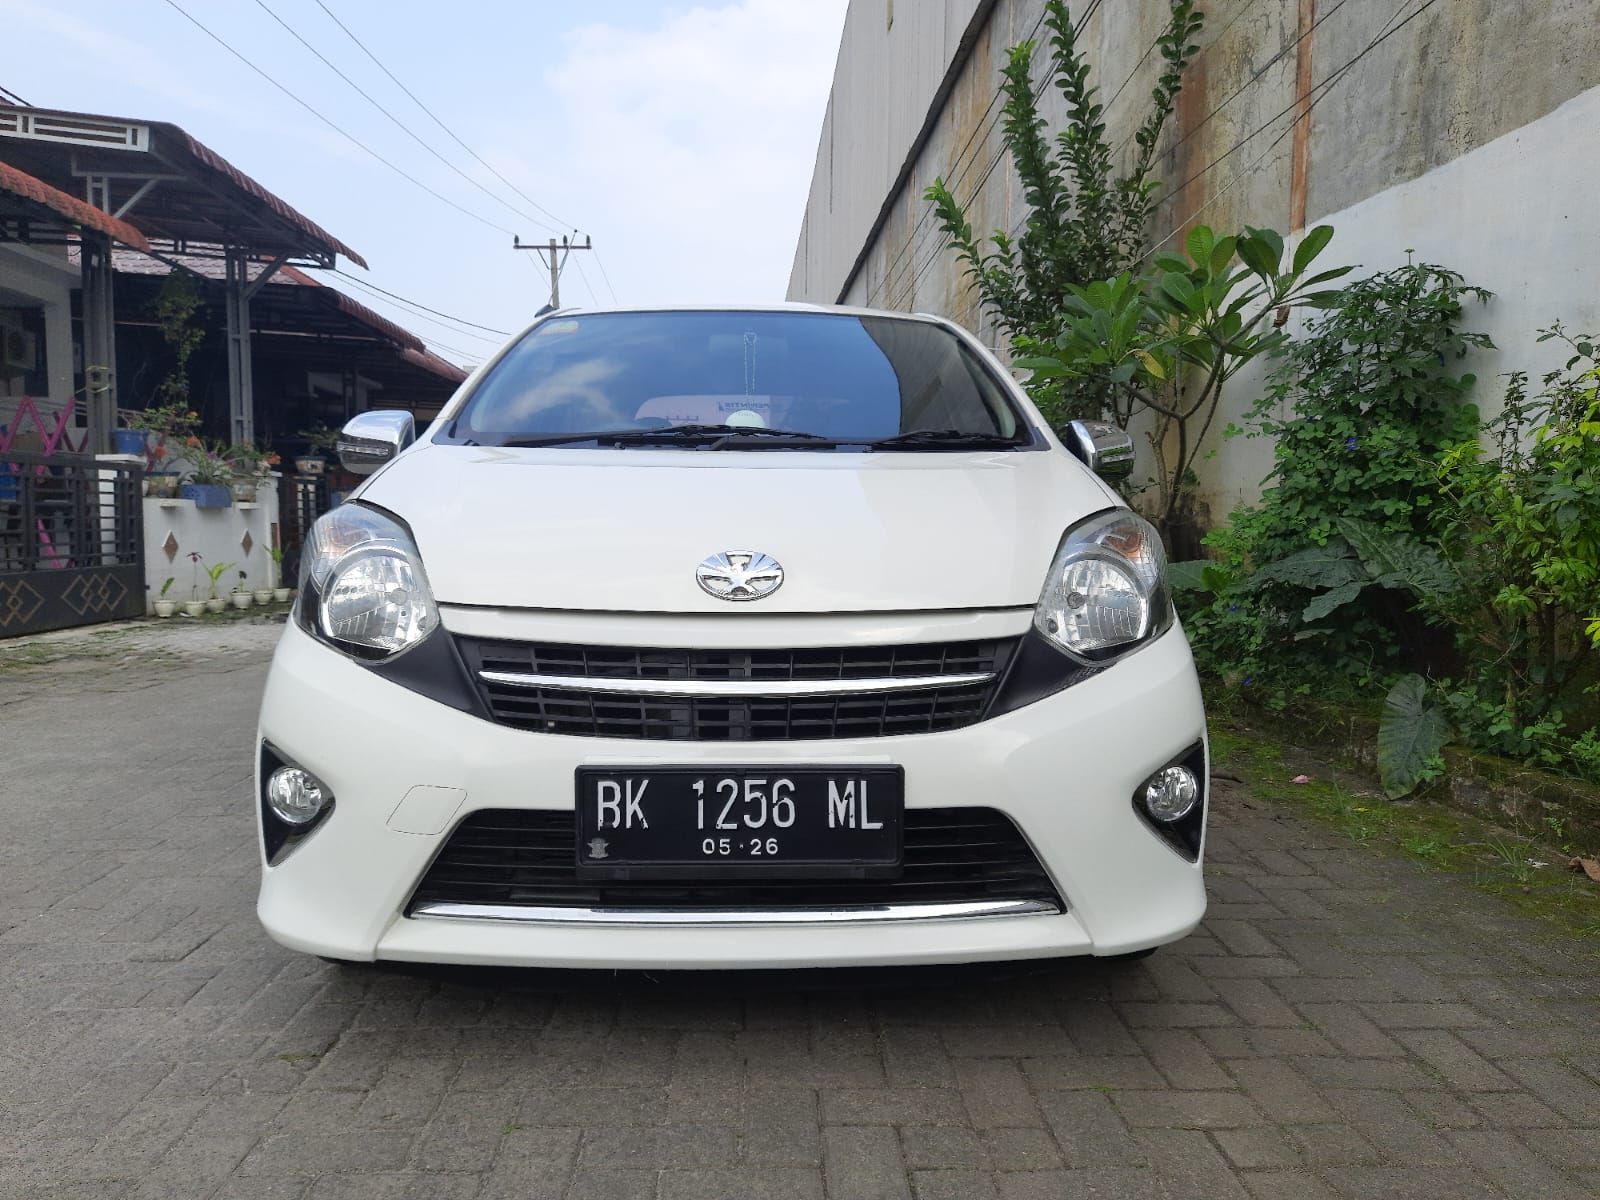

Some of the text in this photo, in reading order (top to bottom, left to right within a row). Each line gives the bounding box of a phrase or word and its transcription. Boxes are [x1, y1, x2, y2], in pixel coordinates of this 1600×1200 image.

[597, 778, 884, 830] BK 1256 ML
